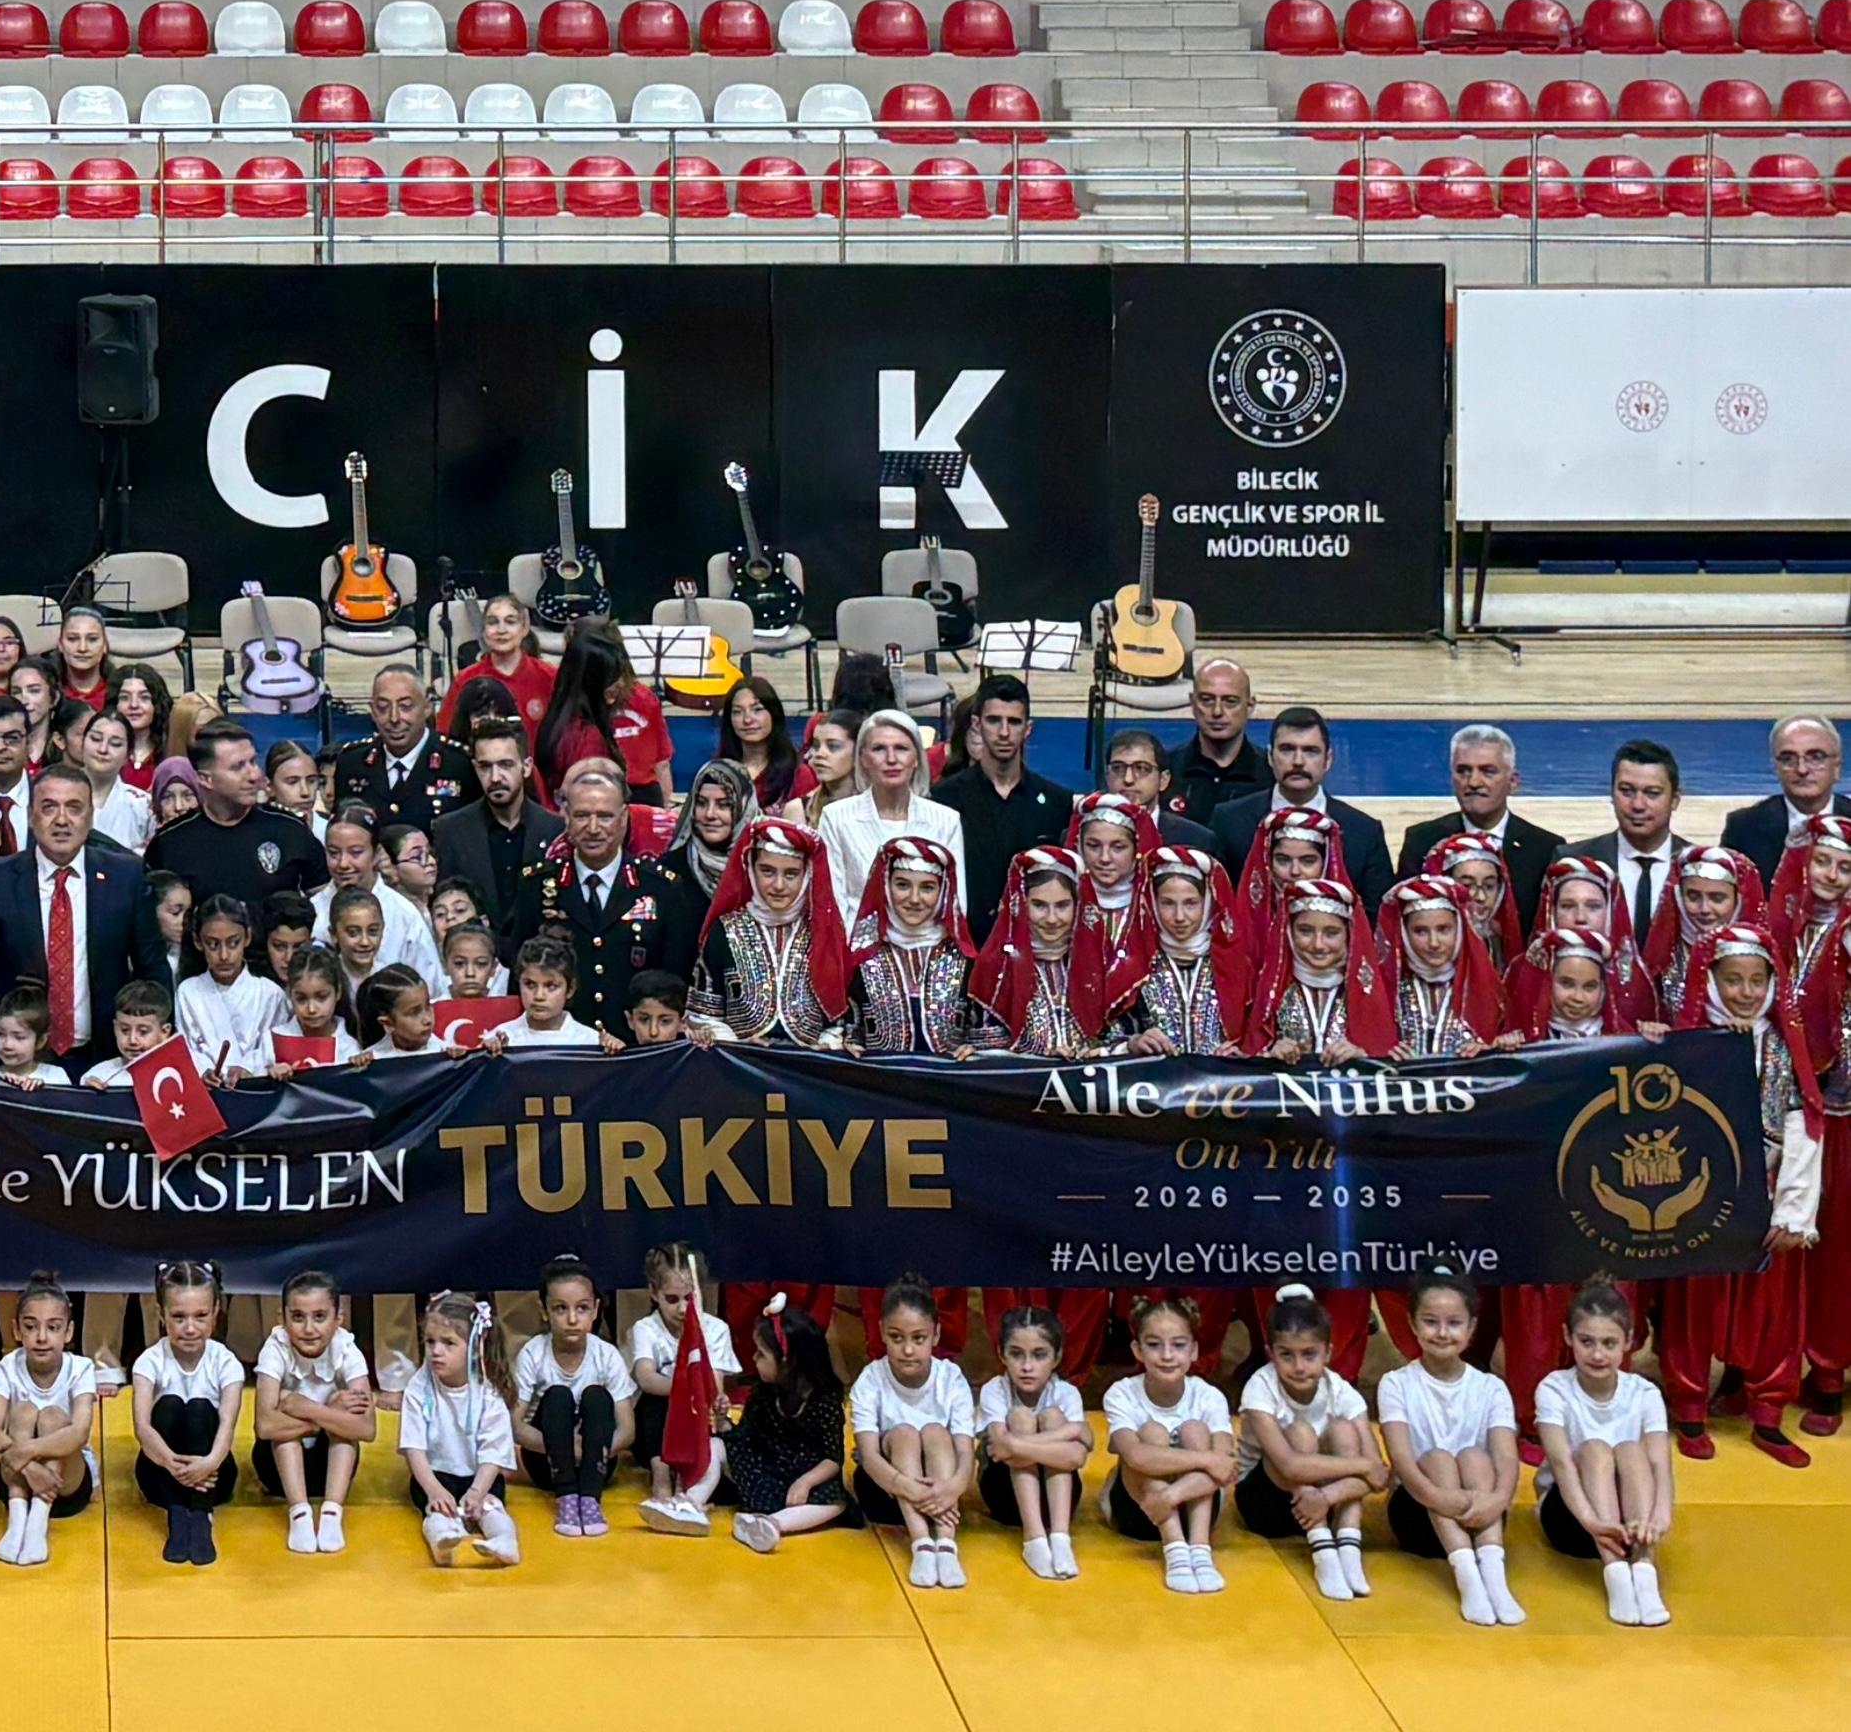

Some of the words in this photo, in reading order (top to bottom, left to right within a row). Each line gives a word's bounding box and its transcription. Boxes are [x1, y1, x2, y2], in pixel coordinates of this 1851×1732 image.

[1237, 468, 1319, 490] BİLECİK
[1172, 500, 1266, 529] GENÇLİK
[1269, 505, 1297, 524] VE
[1302, 504, 1360, 524] SPOR
[1365, 500, 1385, 523] İL
[1206, 535, 1350, 558] MÜDÜRLÜĞÜ
[1032, 1064, 1161, 1118] Aile
[1183, 1080, 1254, 1119] ve
[1273, 1066, 1476, 1119] Nüfus
[42, 1141, 407, 1212] YÜKSELEN
[438, 1093, 952, 1214] TÜRKİYE
[1175, 1136, 1240, 1171] On
[1133, 1186, 1228, 1208] 2026
[1307, 1186, 1402, 1208] 2035
